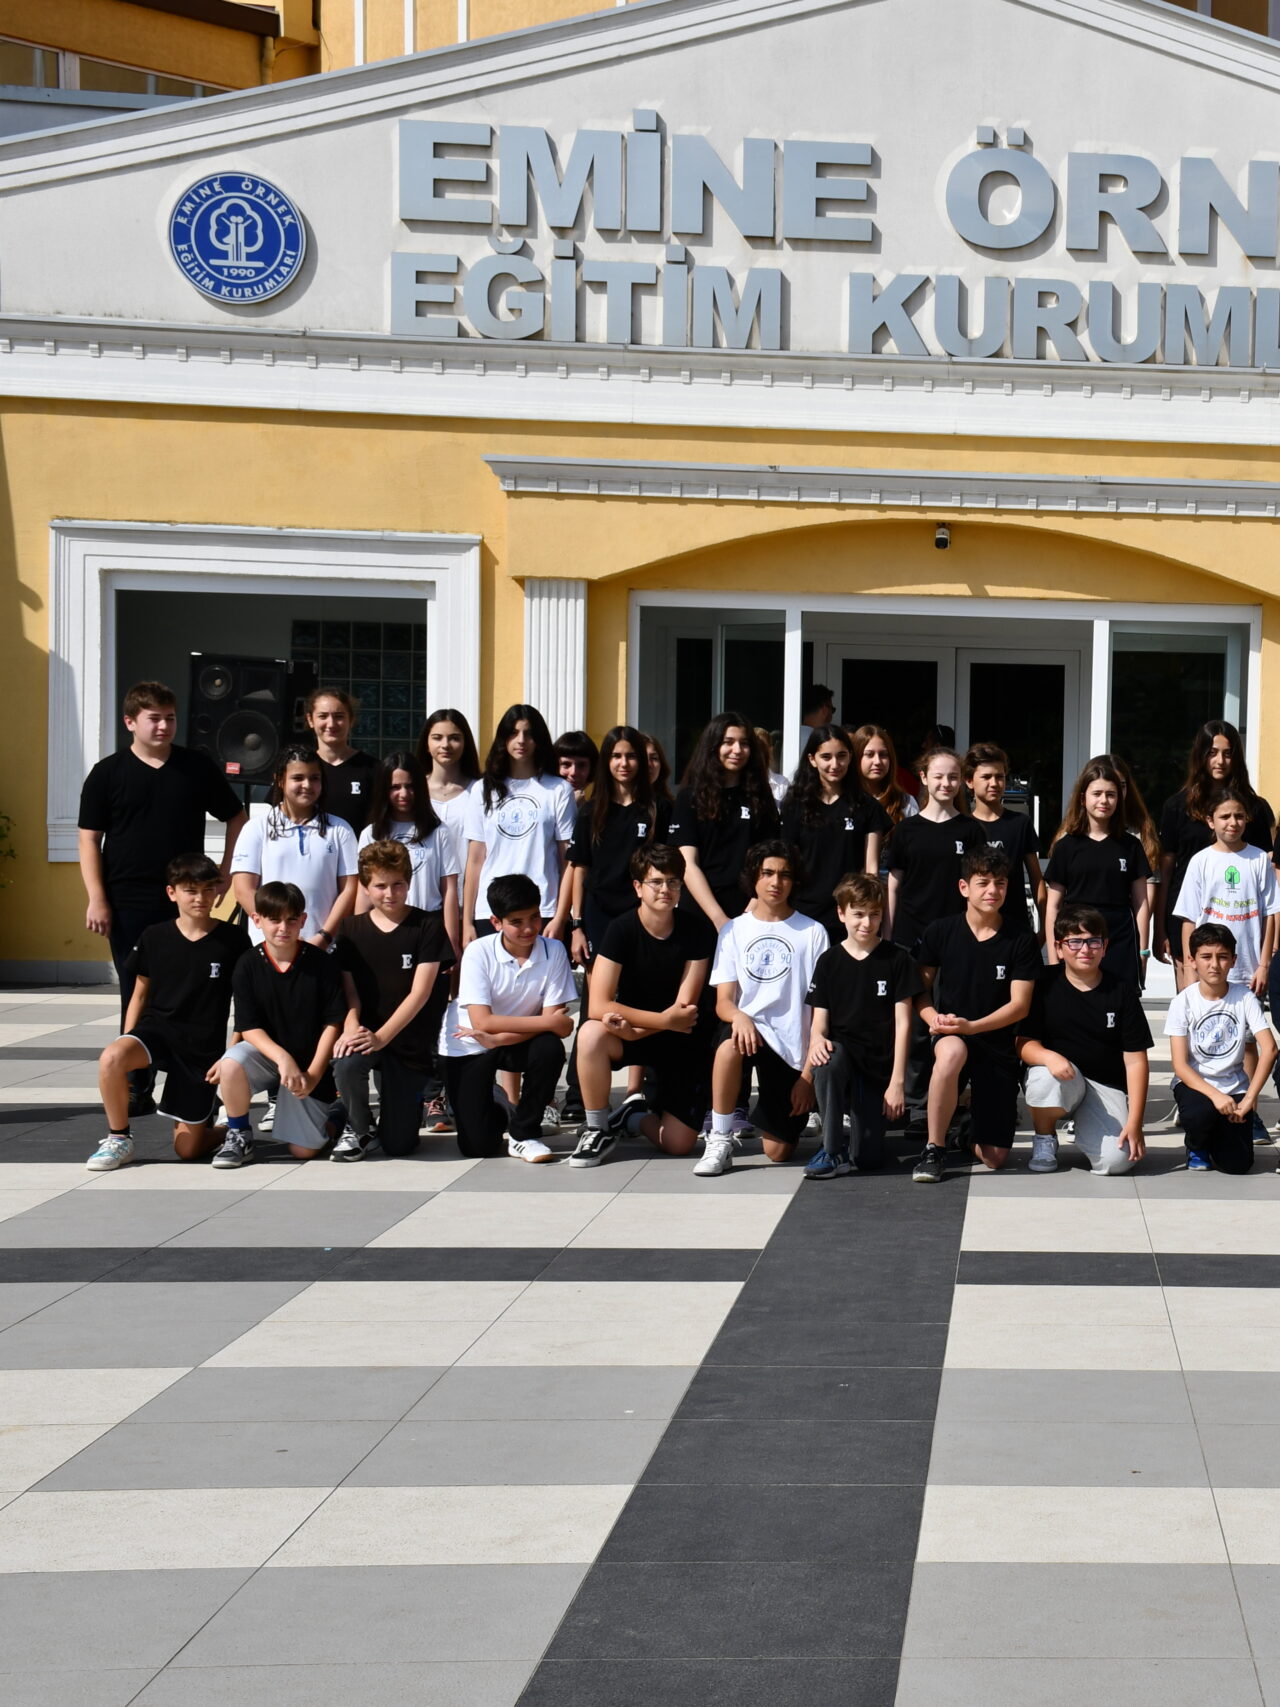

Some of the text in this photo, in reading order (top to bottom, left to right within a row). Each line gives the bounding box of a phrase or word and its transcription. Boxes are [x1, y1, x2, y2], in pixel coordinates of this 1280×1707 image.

[399, 108, 876, 243] EMİNE
[176, 178, 297, 226] EMİNE ÖRNEK
[176, 244, 297, 297] EĞİTİM KURUMLARI
[222, 267, 256, 277] 1990
[391, 235, 784, 350] EĞİTİM
[351, 782, 361, 794] E
[741, 806, 750, 819] E
[638, 823, 646, 837] E
[956, 841, 964, 854] E
[1119, 859, 1127, 871] E
[402, 954, 412, 969] E
[746, 953, 792, 965] 19 90
[210, 963, 220, 977] E
[996, 966, 1006, 979] E
[877, 981, 887, 996] E
[1107, 1013, 1115, 1027] E
[1196, 1025, 1239, 1043] 19 90
